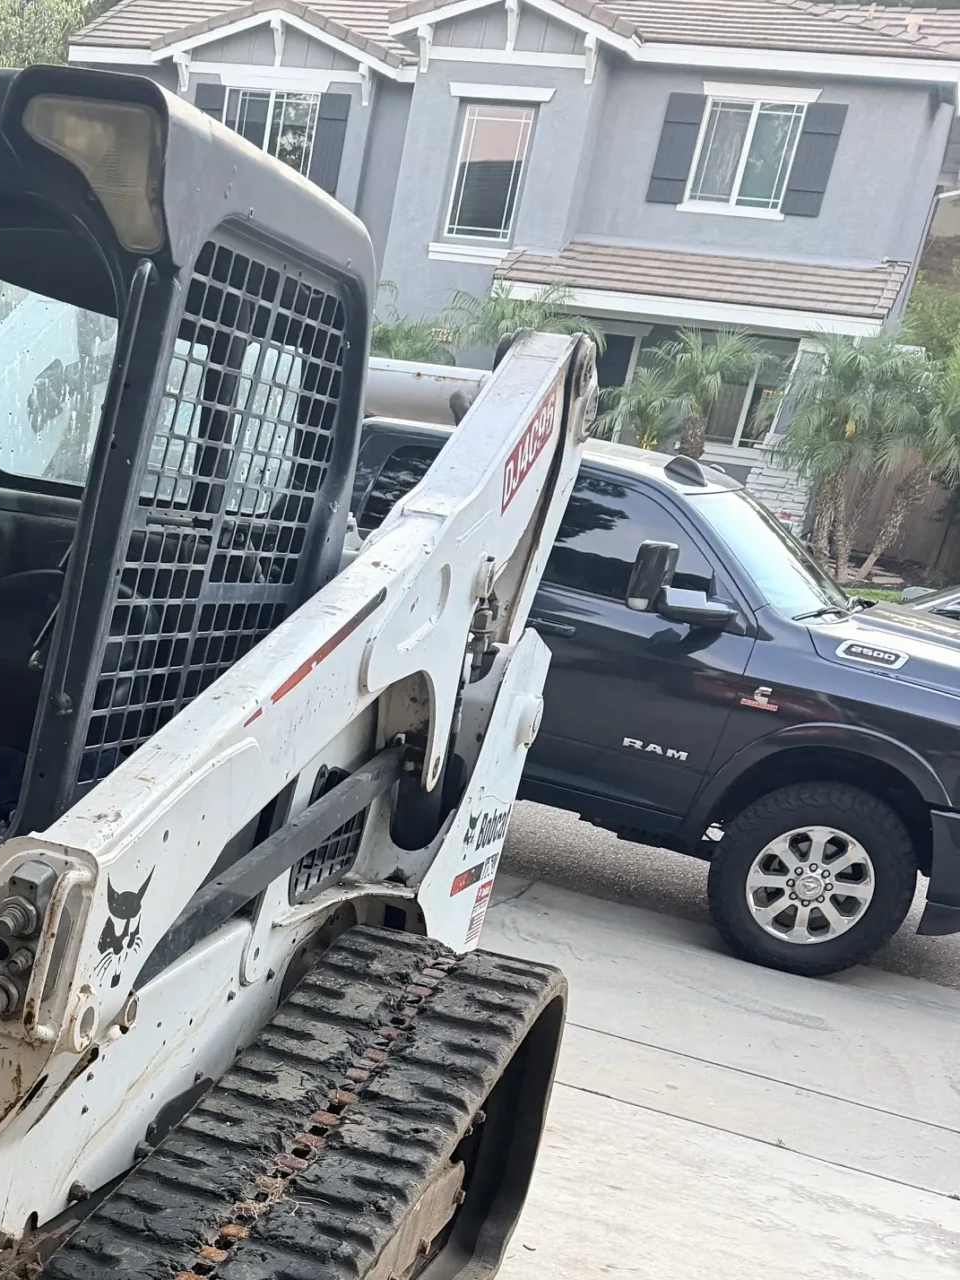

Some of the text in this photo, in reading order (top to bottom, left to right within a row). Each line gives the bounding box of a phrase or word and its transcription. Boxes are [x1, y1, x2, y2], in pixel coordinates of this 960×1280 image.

[850, 645, 896, 661] 2500
[622, 737, 689, 761] RAM
[475, 803, 512, 851] Bobcat
